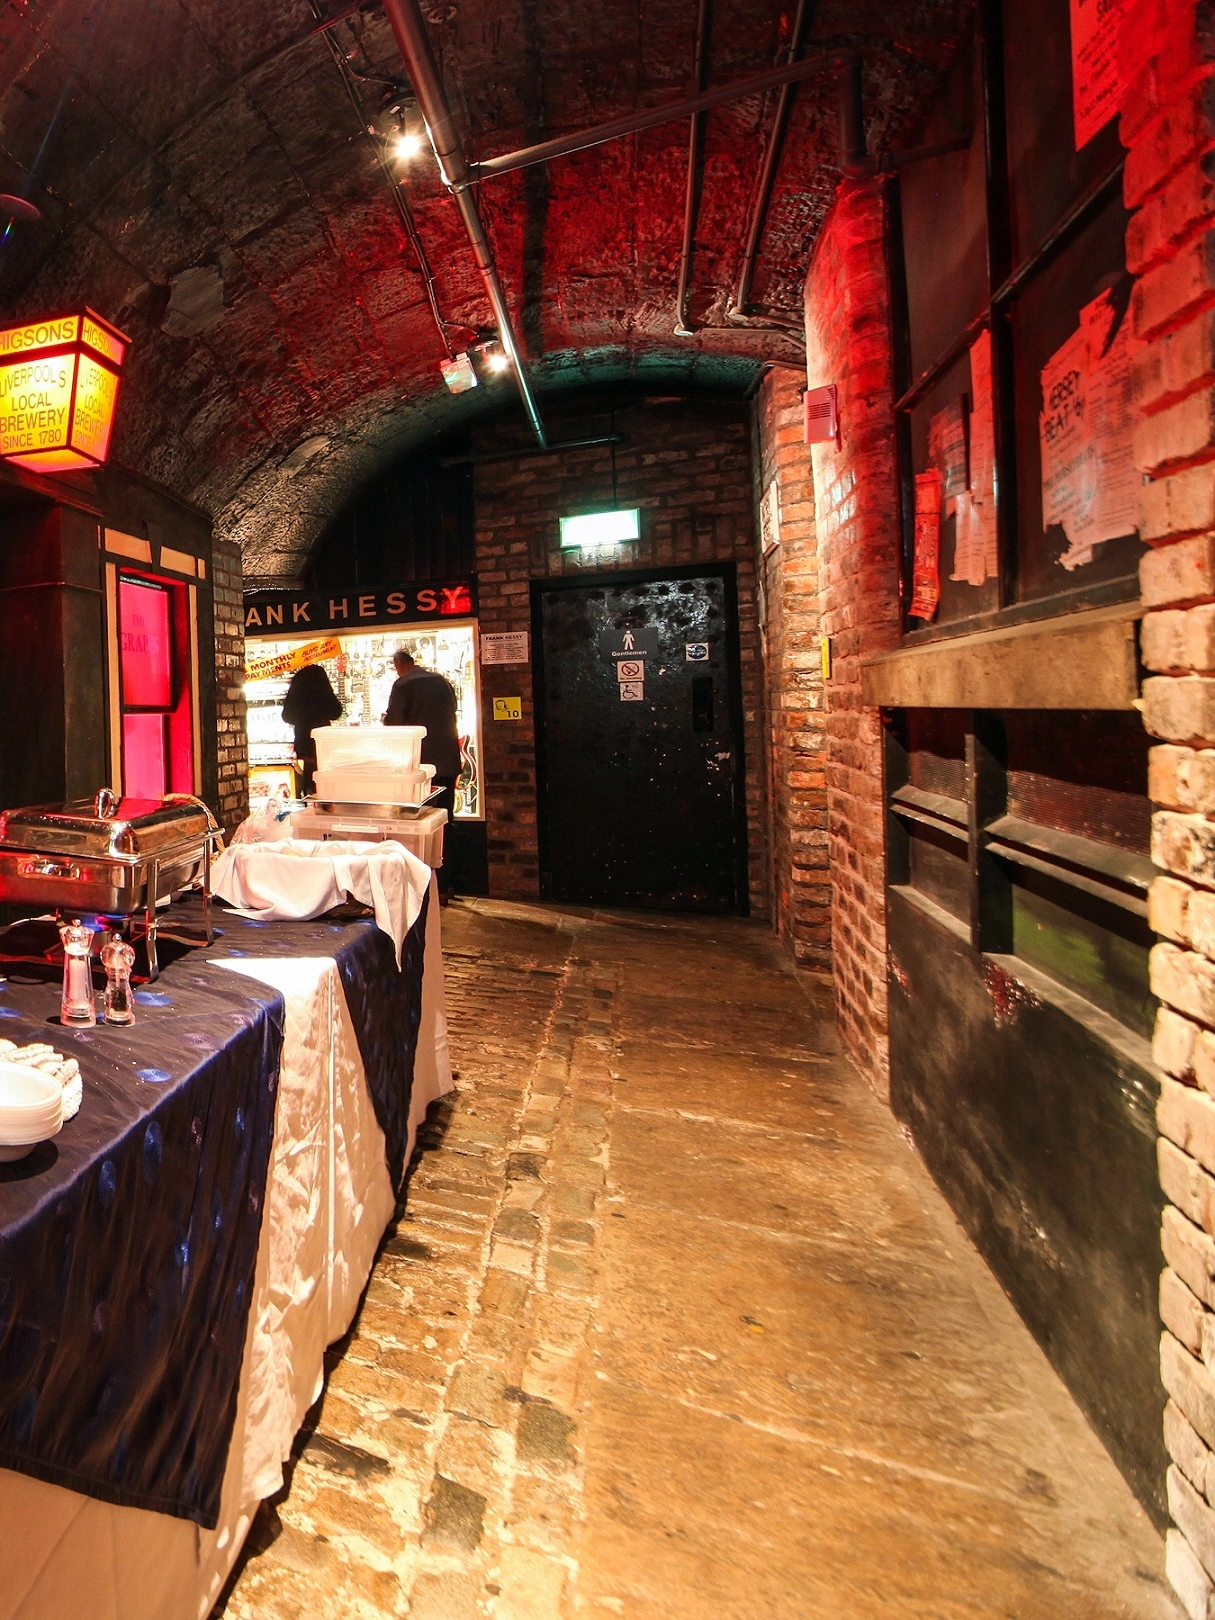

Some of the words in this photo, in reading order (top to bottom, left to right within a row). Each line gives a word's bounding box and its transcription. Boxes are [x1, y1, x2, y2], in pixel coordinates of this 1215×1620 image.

[11, 391, 52, 412] LOCAL
[0, 407, 66, 434] BREWERY
[2, 433, 33, 450] SINCE
[38, 429, 62, 445] 1780
[245, 601, 311, 628] ANK
[329, 585, 464, 620] HESSY
[245, 661, 292, 680] PAYMENTS
[249, 651, 296, 672] MONTHLY
[506, 710, 520, 718] 10
